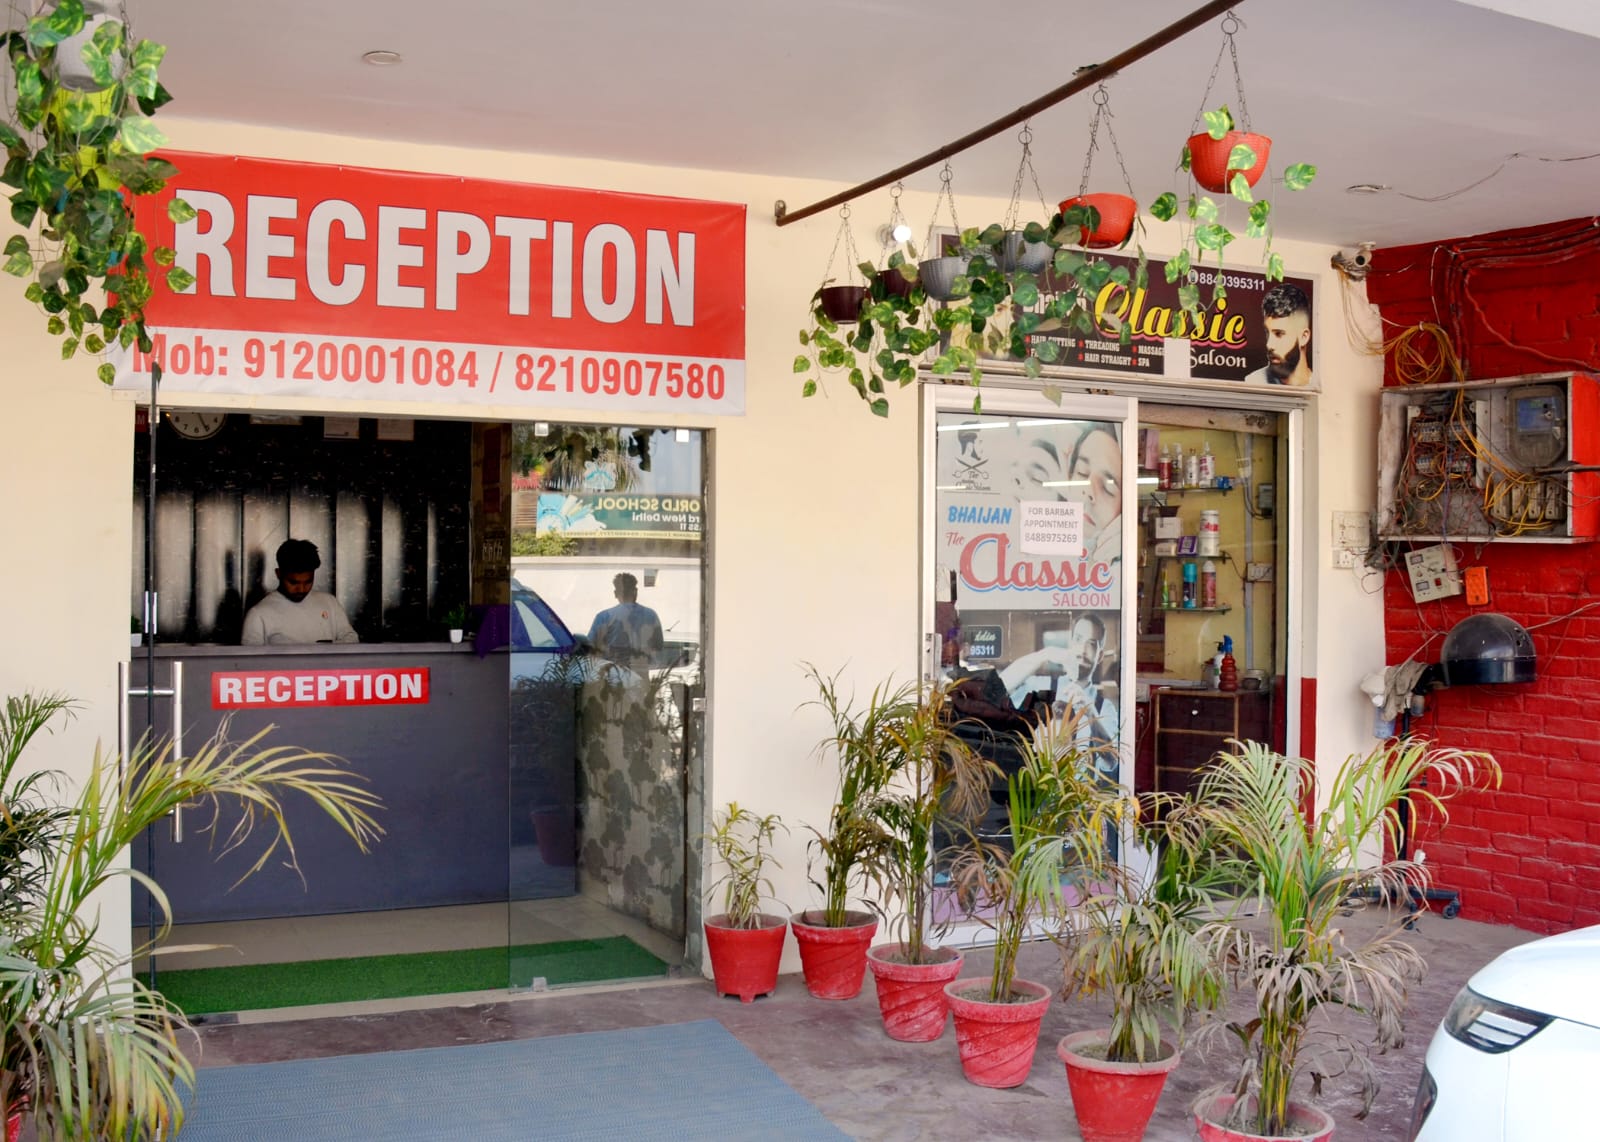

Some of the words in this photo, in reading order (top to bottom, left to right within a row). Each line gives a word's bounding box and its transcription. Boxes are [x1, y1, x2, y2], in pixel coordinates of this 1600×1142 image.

[172, 187, 697, 327] RECEPTION
[1085, 340, 1120, 352] THREADING
[1138, 345, 1164, 356] MASSAG
[1084, 352, 1100, 364] HAIR
[1138, 357, 1150, 367] SPA
[133, 333, 228, 377] Mob:
[243, 337, 478, 390] 9120001084
[514, 352, 726, 402] 8210907580
[948, 506, 1012, 524] BHAIJAN
[1028, 507, 1043, 515] FOR
[1045, 508, 1074, 516] BARBAR
[1024, 520, 1078, 528] APPOINTMENT
[960, 533, 1113, 592] Classic
[1052, 593, 1111, 607] SALOON
[219, 674, 422, 704] RECEPTION
